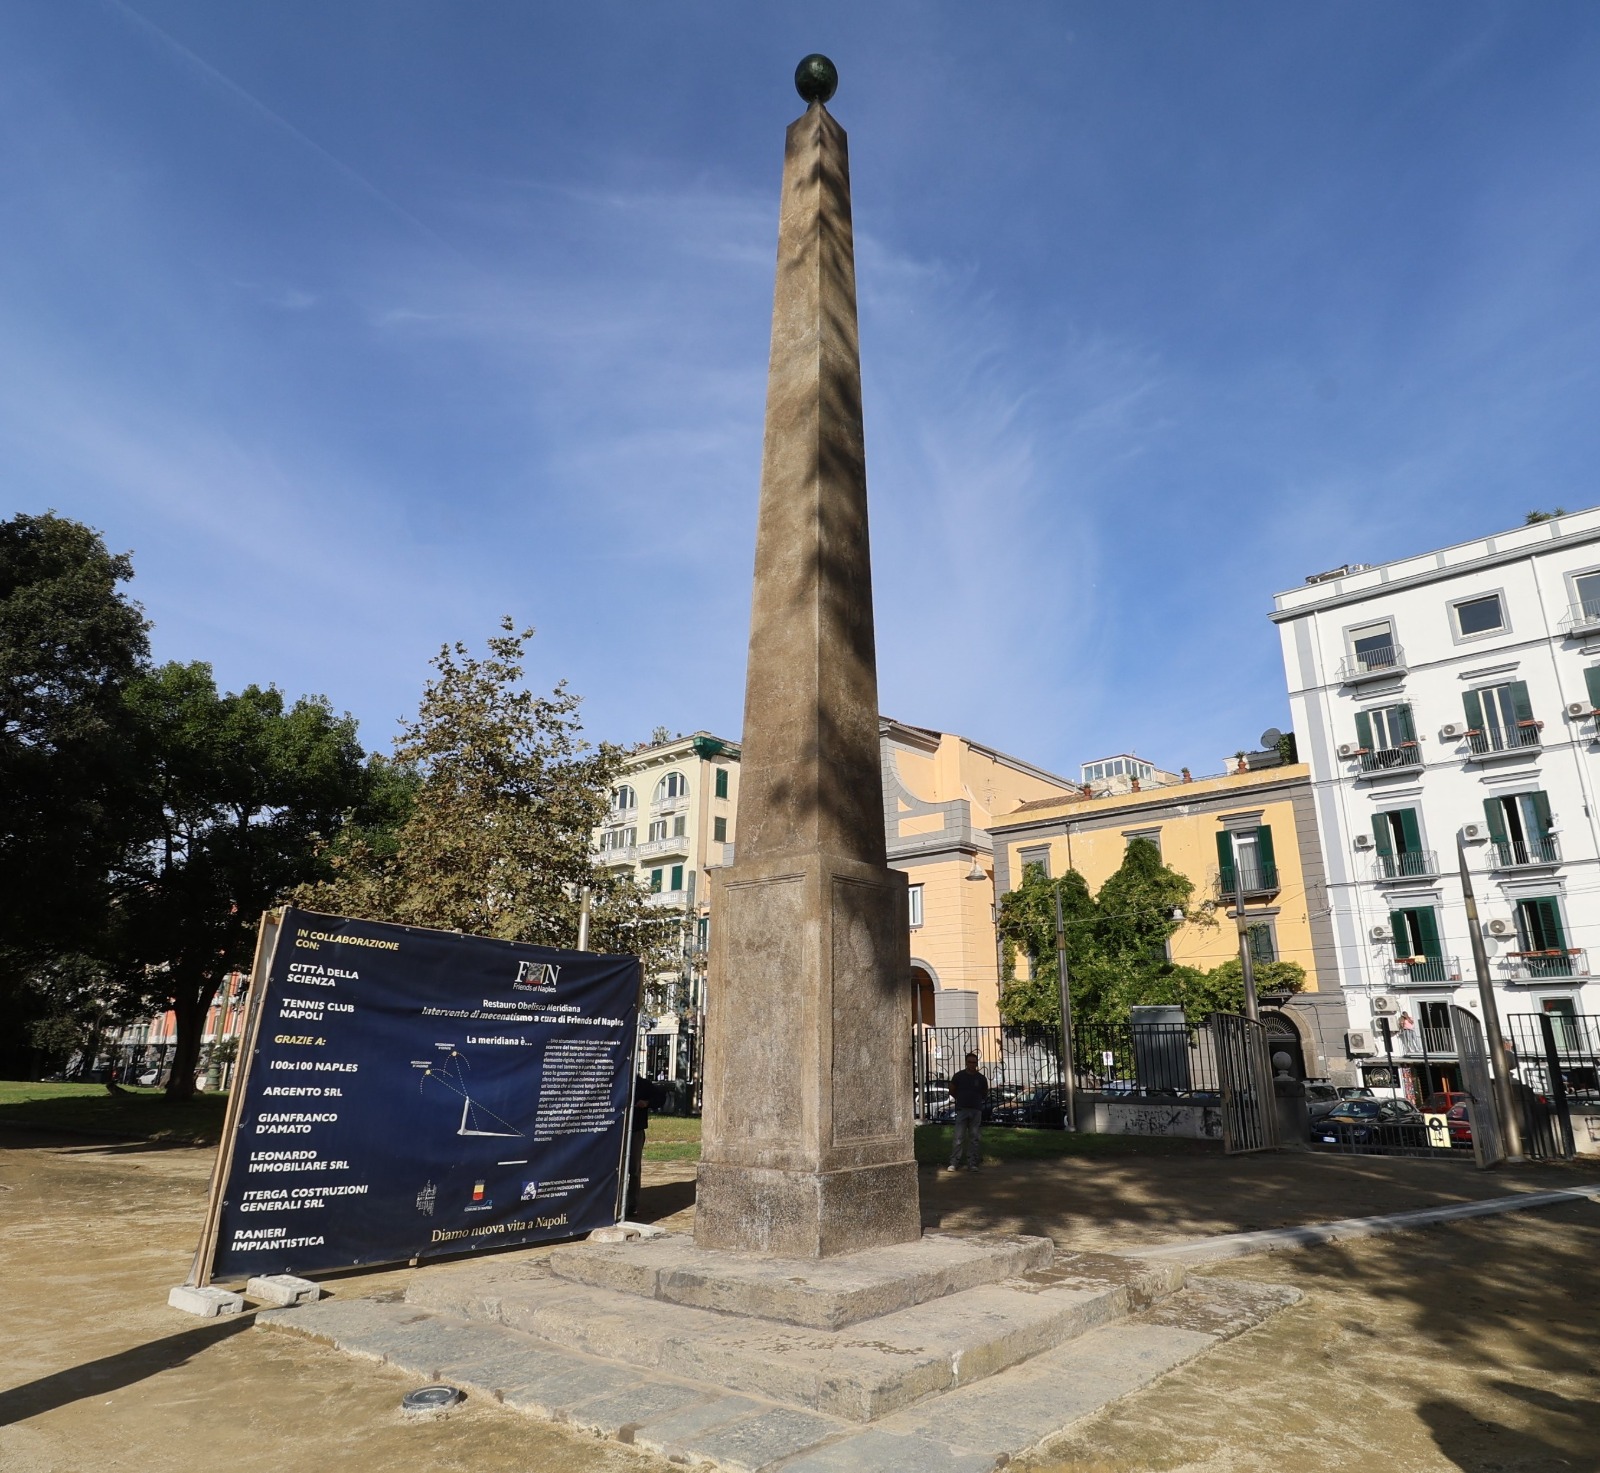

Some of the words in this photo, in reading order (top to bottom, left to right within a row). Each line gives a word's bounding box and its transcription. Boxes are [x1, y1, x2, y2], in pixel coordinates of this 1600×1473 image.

[296, 939, 320, 950] CON:
[297, 929, 308, 938] IN
[310, 931, 400, 951] COLLABORAZIONE
[290, 963, 324, 975] CITTÀ
[327, 968, 359, 980] DELLA
[286, 974, 336, 986] SCIENZA
[513, 983, 532, 992] Friends
[538, 986, 556, 994] Naples
[282, 998, 325, 1010] TENNIS
[328, 1002, 354, 1012] CLUB
[482, 1000, 516, 1010] Restauro
[518, 1001, 546, 1011] Obelisco
[546, 1002, 580, 1012] Meridiana
[280, 1009, 324, 1020] NAPOLI
[422, 1006, 469, 1018] Intervento
[470, 1010, 480, 1019] di
[480, 1011, 533, 1022] mecenatismo
[558, 1014, 566, 1024] di
[567, 1015, 592, 1025] Friends
[593, 1016, 600, 1026] of
[602, 1017, 624, 1028] Naples
[274, 1034, 314, 1045] GRAZIE
[314, 1037, 326, 1046] A:
[466, 1036, 477, 1044] La
[478, 1036, 519, 1046] meridiana
[520, 1036, 533, 1046] è...
[270, 1060, 313, 1071] 100x100
[315, 1062, 358, 1072] NAPLES
[263, 1086, 322, 1096] ARGENTO
[324, 1088, 342, 1097] SRL
[258, 1113, 338, 1123] GIANFRANCO
[256, 1124, 312, 1134] D'AMATO
[250, 1150, 317, 1161] LEONARDO
[248, 1161, 328, 1173] IMMOBILIARE
[330, 1160, 350, 1170] SRL
[243, 1190, 288, 1200] ITERGA
[291, 1185, 368, 1198] COSTRUZIONI
[240, 1200, 300, 1212] GENERALI
[304, 1199, 325, 1209] SRL
[234, 1228, 286, 1240] RANIERI
[431, 1229, 469, 1243] Diamo
[471, 1224, 505, 1236] nuova
[508, 1220, 526, 1232] vita
[535, 1213, 569, 1228] Napoli.
[231, 1236, 325, 1252] IMPIANTISTICA
